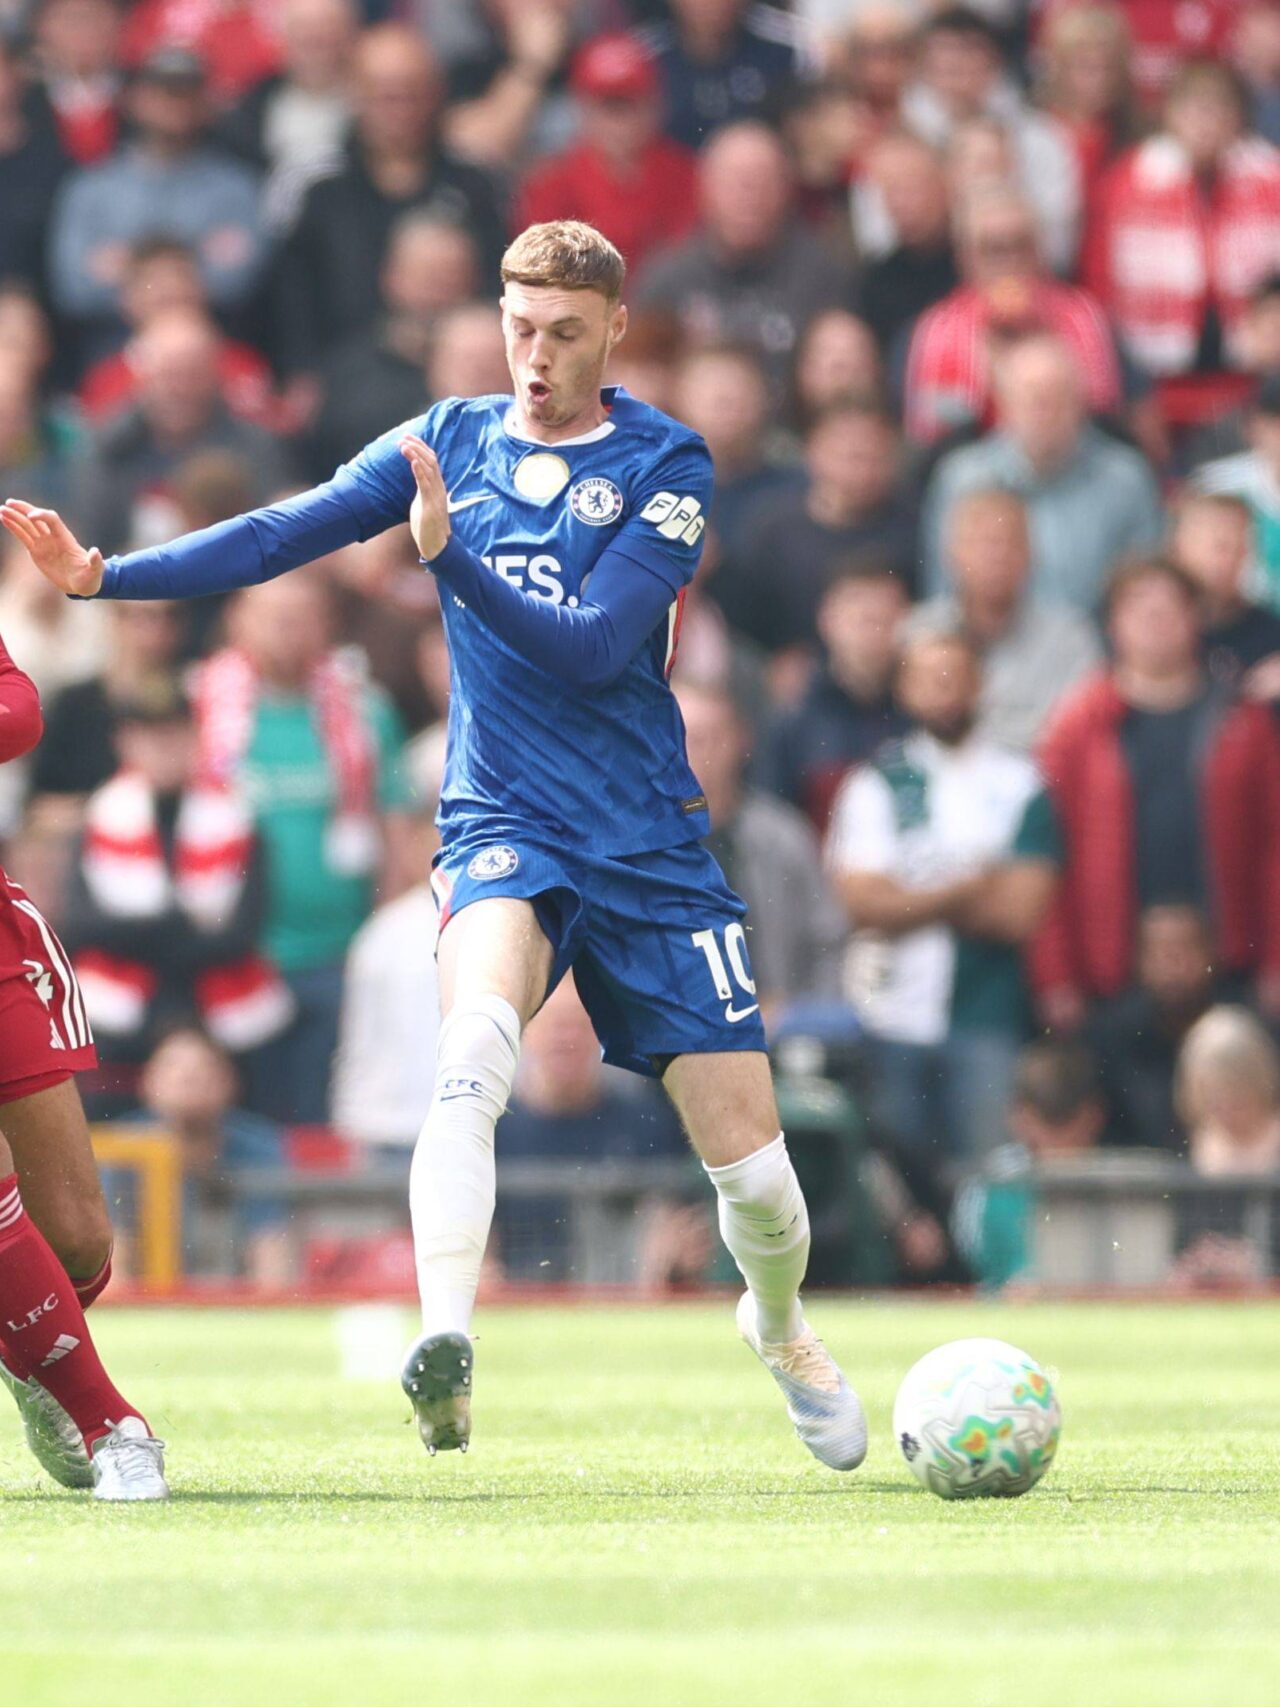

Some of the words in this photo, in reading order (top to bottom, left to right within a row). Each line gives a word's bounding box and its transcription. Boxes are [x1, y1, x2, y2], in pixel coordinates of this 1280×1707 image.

[647, 498, 703, 538] FPT
[691, 922, 756, 1000] 10
[6, 1292, 59, 1332] LFC
